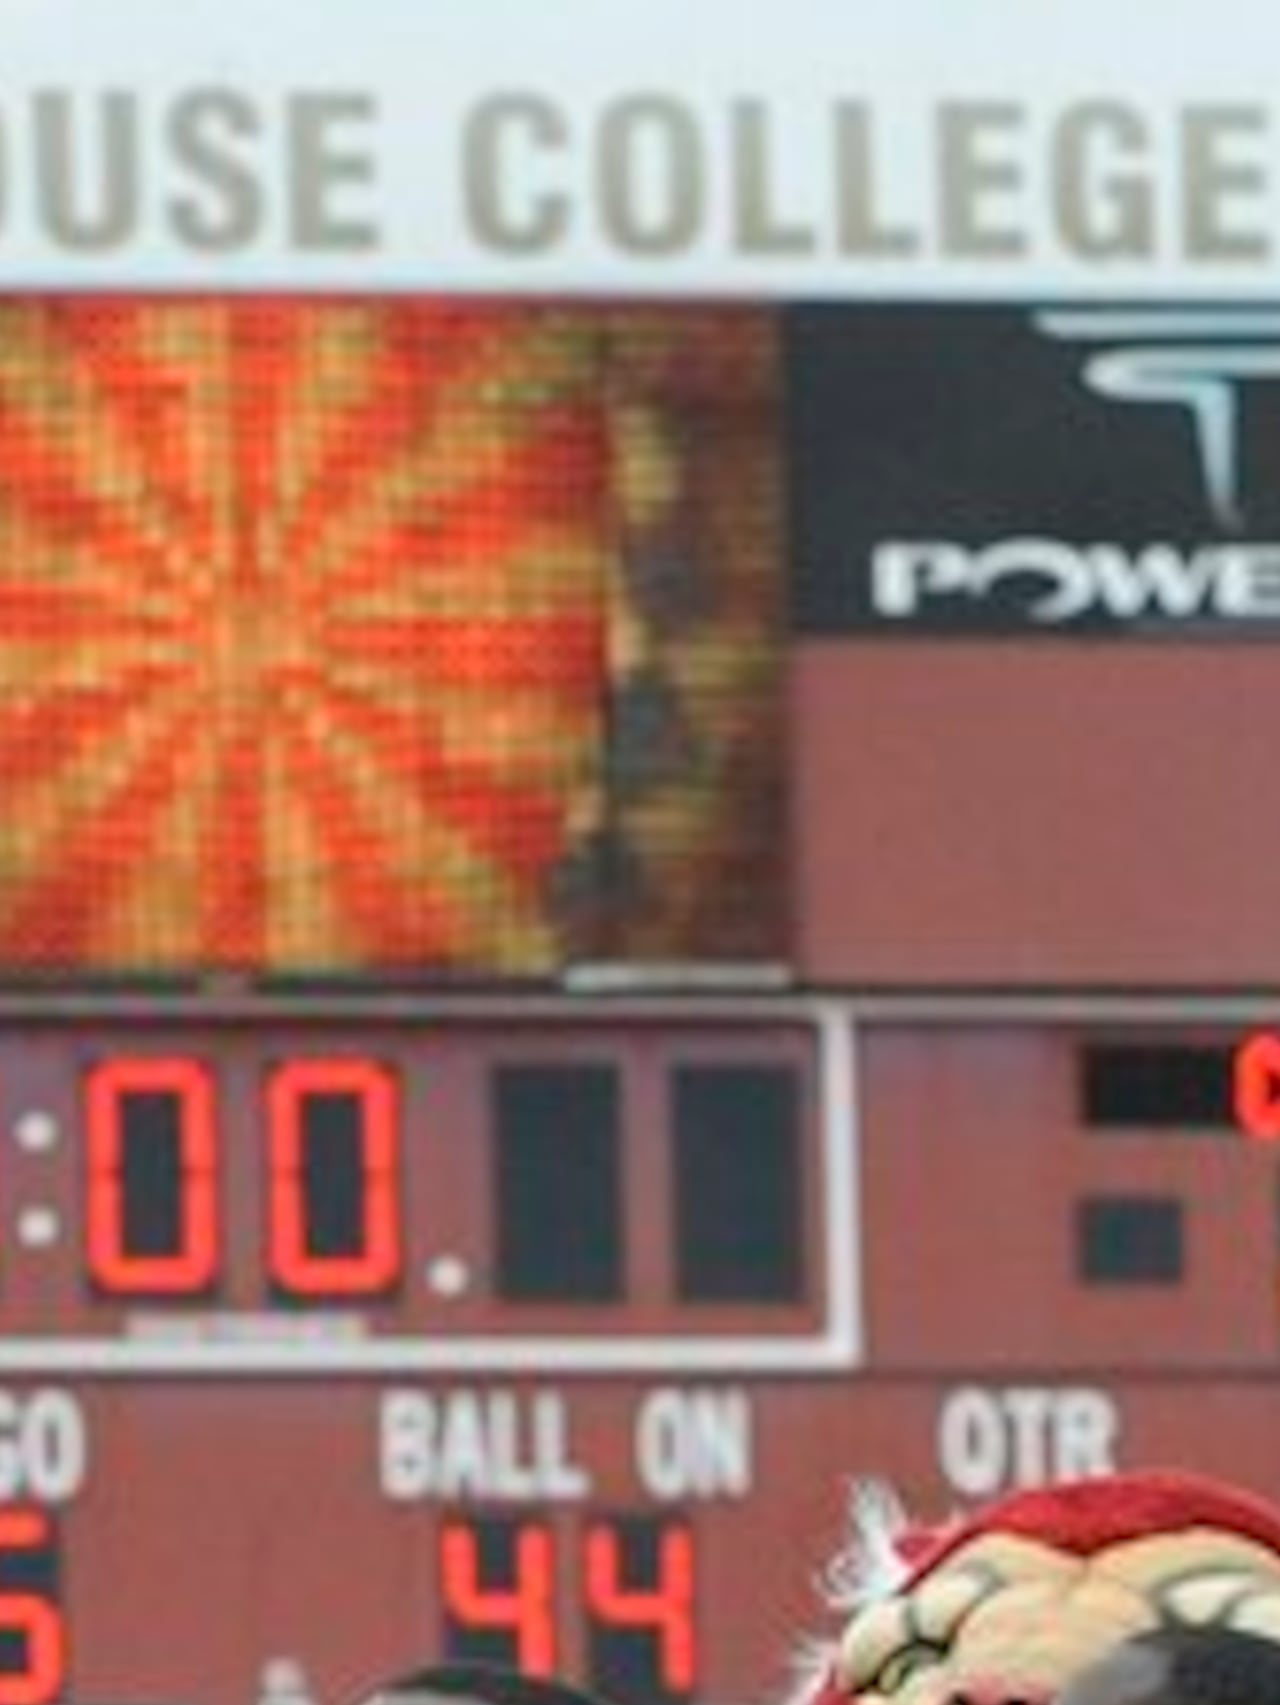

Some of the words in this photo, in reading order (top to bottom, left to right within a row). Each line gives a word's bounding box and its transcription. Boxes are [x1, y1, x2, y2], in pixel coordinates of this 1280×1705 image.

[460, 90, 1273, 264] COLLEGE
[378, 1388, 588, 1502] BALL
[634, 1388, 752, 1500] ON
[440, 1522, 698, 1696] 44
